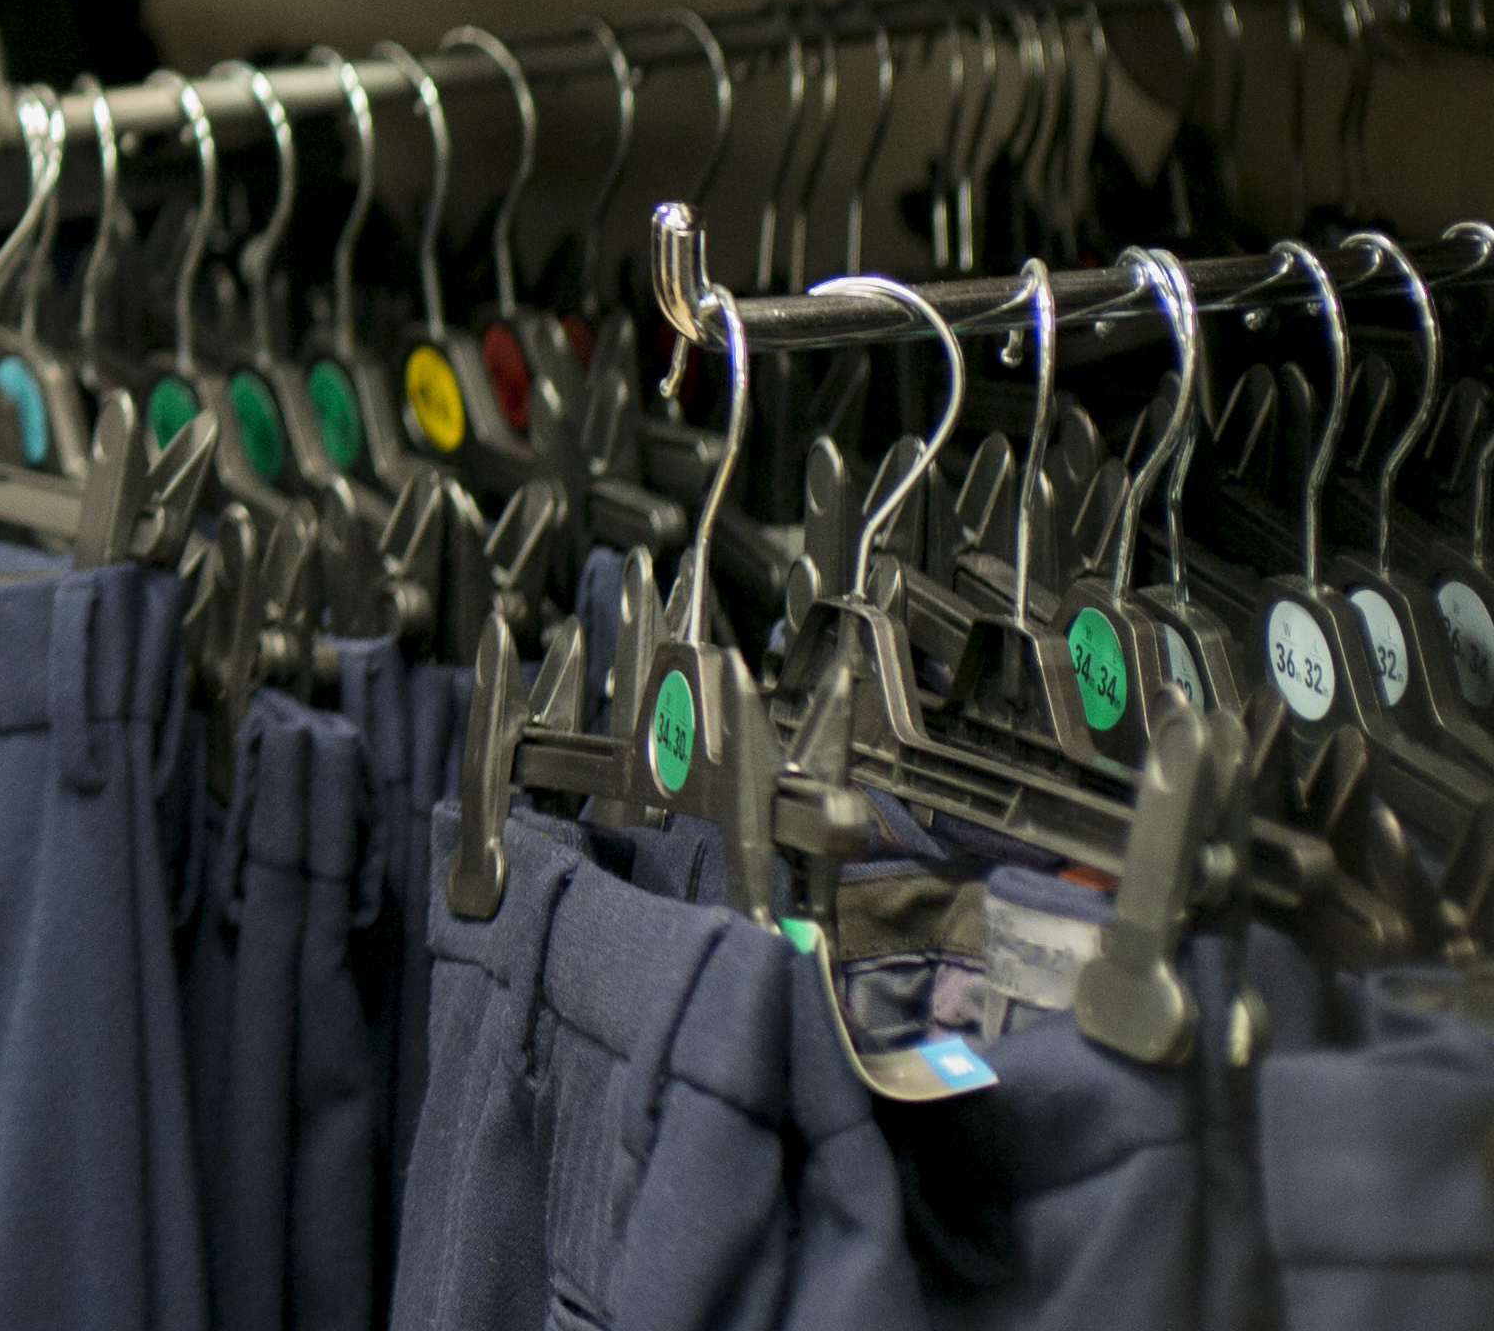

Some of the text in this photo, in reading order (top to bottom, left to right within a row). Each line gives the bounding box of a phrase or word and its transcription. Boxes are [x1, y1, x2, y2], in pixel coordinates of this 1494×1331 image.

[1276, 642, 1323, 695] 36 32
[1376, 645, 1398, 681] 32
[1097, 665, 1118, 707] 34
